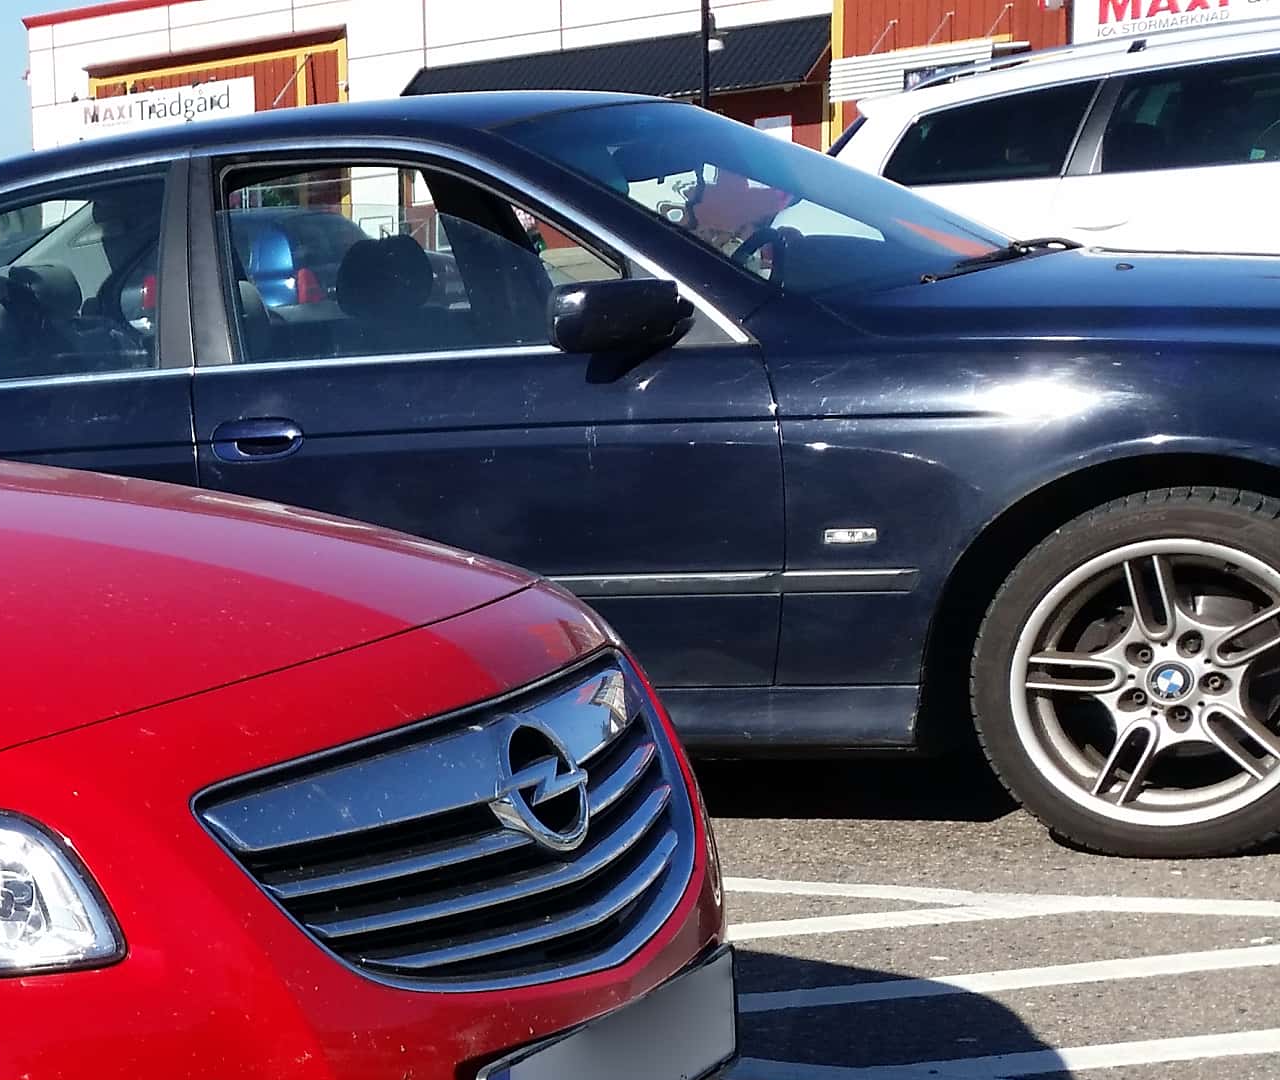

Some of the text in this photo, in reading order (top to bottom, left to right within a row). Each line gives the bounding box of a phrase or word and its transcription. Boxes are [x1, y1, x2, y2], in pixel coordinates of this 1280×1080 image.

[1122, 9, 1230, 34] STORMARKNAD
[83, 84, 230, 125] MAXI Trädgård
